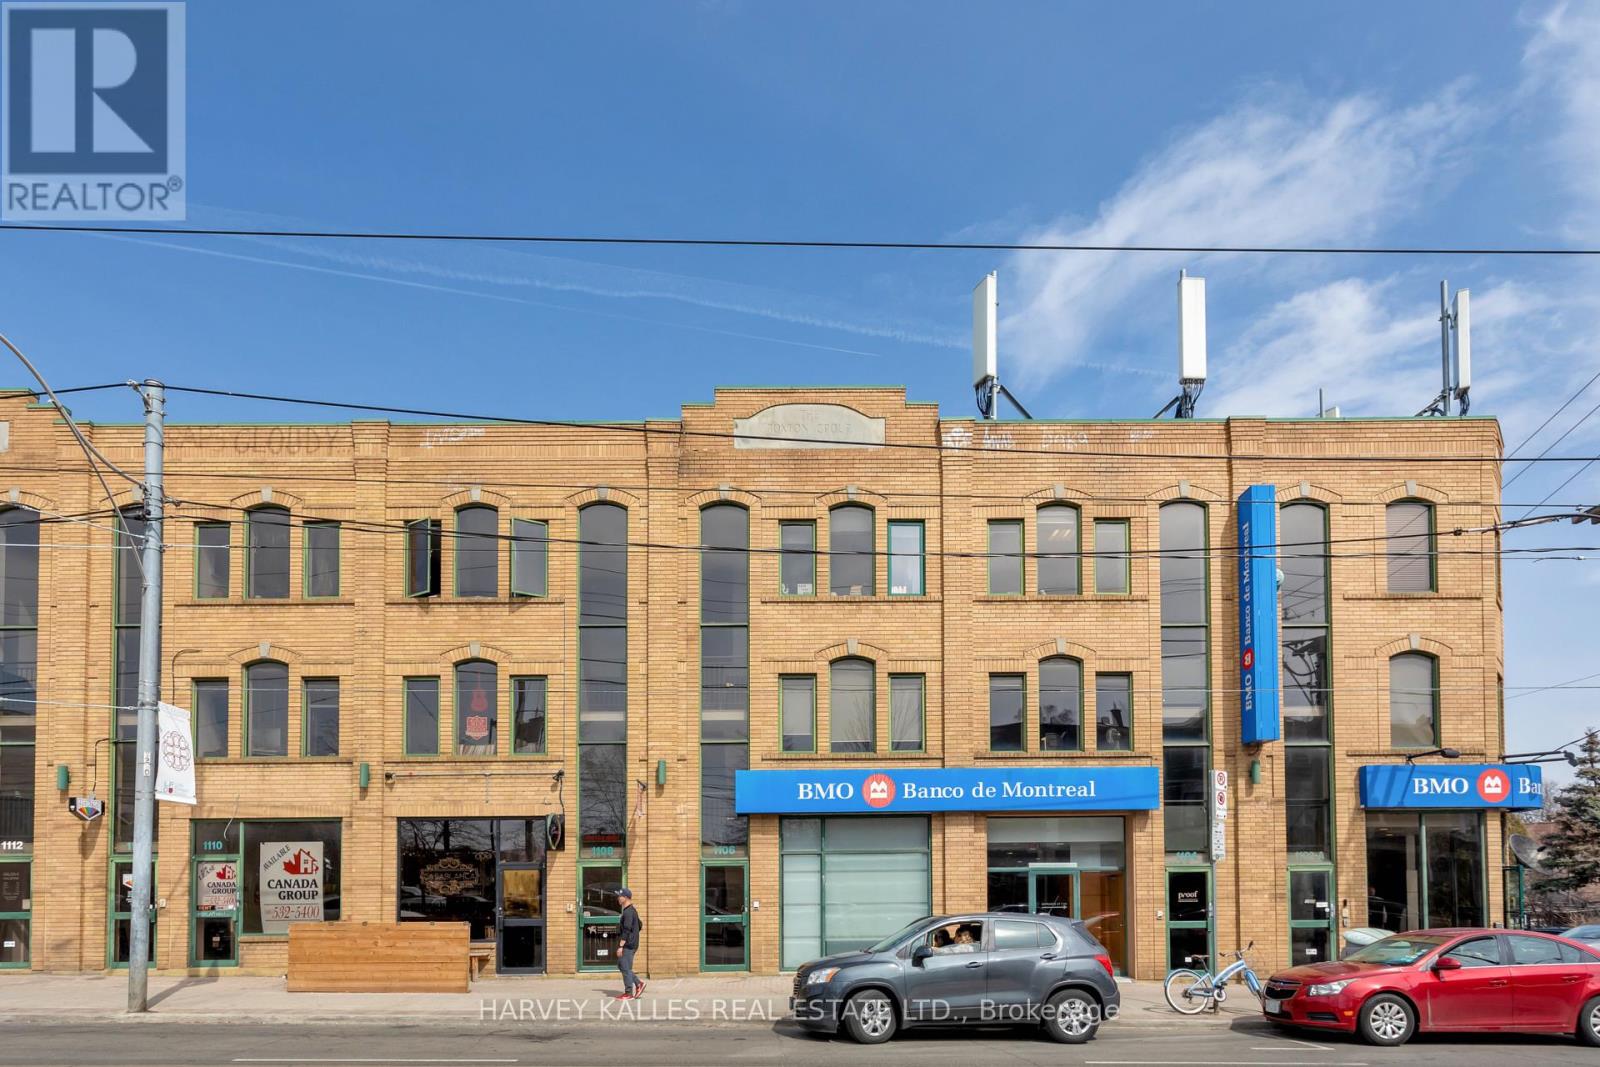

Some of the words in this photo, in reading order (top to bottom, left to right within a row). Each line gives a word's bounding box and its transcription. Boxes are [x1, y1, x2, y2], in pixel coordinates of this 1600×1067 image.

[1242, 521, 1251, 585] Montreal
[1243, 585, 1251, 602] de
[1244, 605, 1252, 646] Banco
[1245, 674, 1253, 711] BMO
[797, 782, 854, 800] BMO
[903, 782, 964, 799] Banco
[971, 781, 997, 798] de
[1001, 780, 1097, 798] Montreal
[1413, 777, 1469, 794] BMO
[1, 840, 23, 850] 1112
[203, 840, 223, 850] 1110
[267, 879, 319, 889] CANADA
[278, 890, 319, 900] GROUP
[1178, 890, 1199, 899] proof
[271, 905, 320, 919] 532-5400
